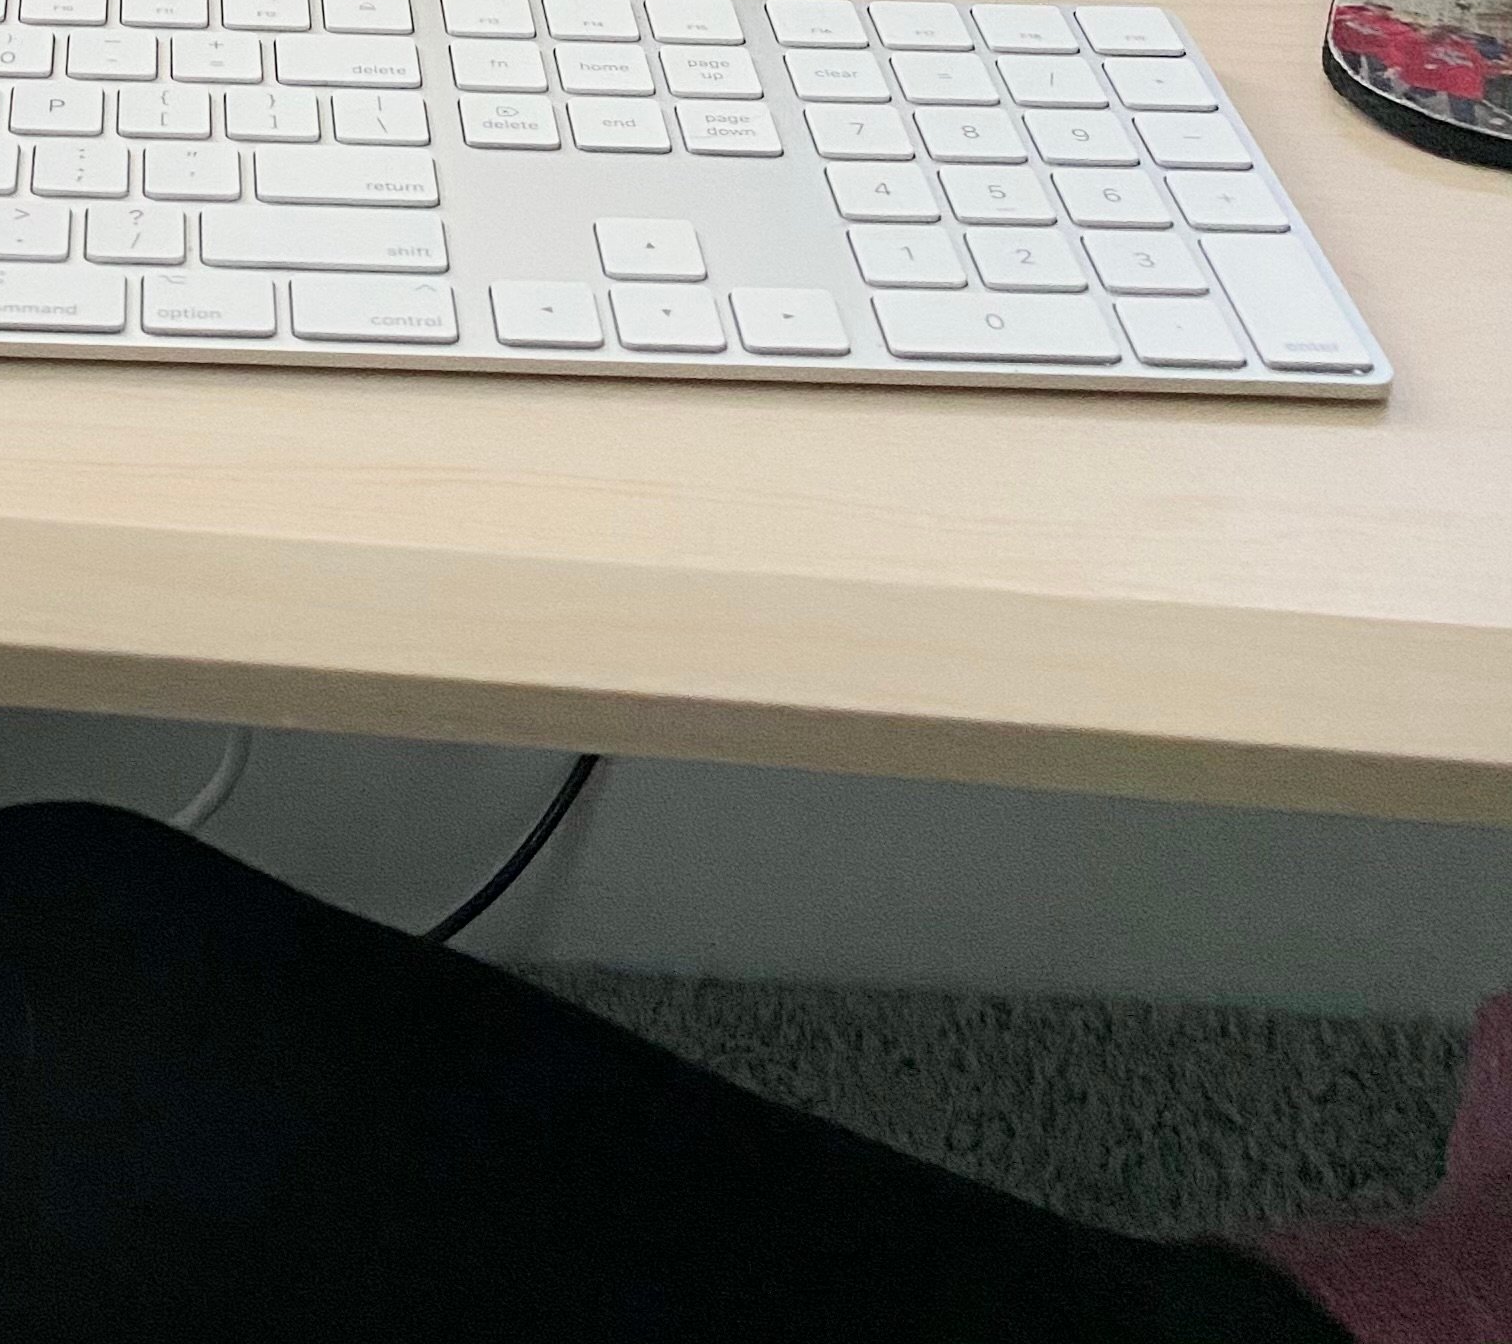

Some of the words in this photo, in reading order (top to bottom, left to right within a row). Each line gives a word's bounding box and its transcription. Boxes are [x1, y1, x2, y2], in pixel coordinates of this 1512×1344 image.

[490, 59, 508, 67] fn
[580, 62, 629, 72] home
[687, 59, 730, 70] page
[352, 66, 406, 75] delete
[701, 70, 723, 82] up
[814, 69, 857, 78] clear
[49, 99, 65, 112] P
[482, 121, 538, 129] delete
[602, 119, 636, 127] end
[705, 113, 750, 125] page
[707, 125, 756, 137] down
[854, 123, 864, 135] 7
[961, 125, 980, 139] 8
[1071, 129, 1090, 141] 9
[366, 183, 424, 192] return
[875, 183, 891, 195] 4
[988, 185, 1006, 199] 5
[1103, 188, 1121, 202] 6
[387, 247, 431, 257] shift
[1016, 249, 1034, 264] 2
[1134, 252, 1155, 268] 3
[157, 308, 222, 320] option
[370, 316, 442, 327] control
